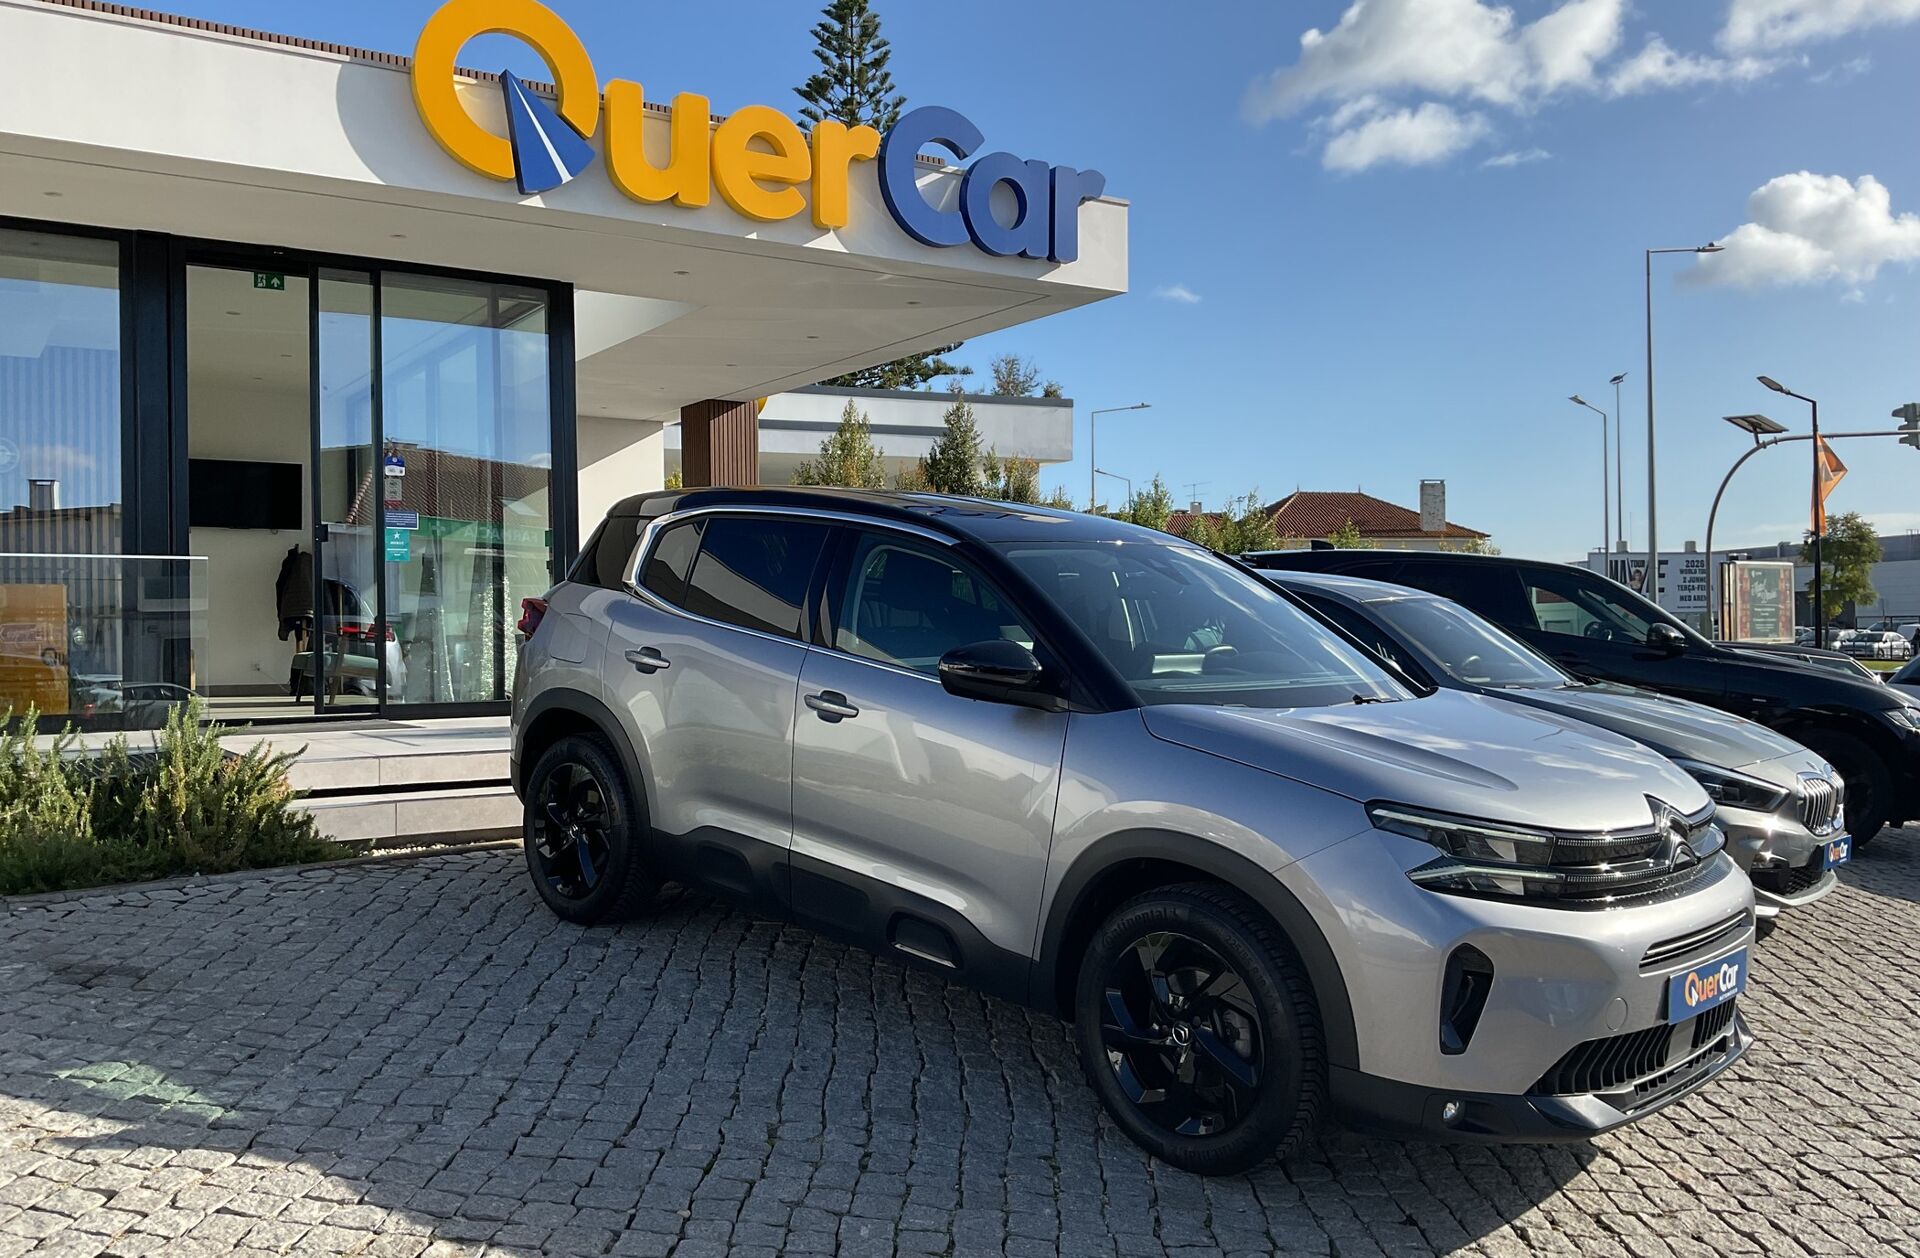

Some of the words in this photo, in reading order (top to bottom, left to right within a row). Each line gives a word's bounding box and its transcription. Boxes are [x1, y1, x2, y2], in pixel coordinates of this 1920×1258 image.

[411, 0, 1105, 264] QuerCar
[1685, 559, 1705, 568] 2026
[1677, 584, 1714, 593] TERÇA-FEI
[1692, 594, 1707, 602] AREN
[1684, 963, 1739, 1007] QuerCar
